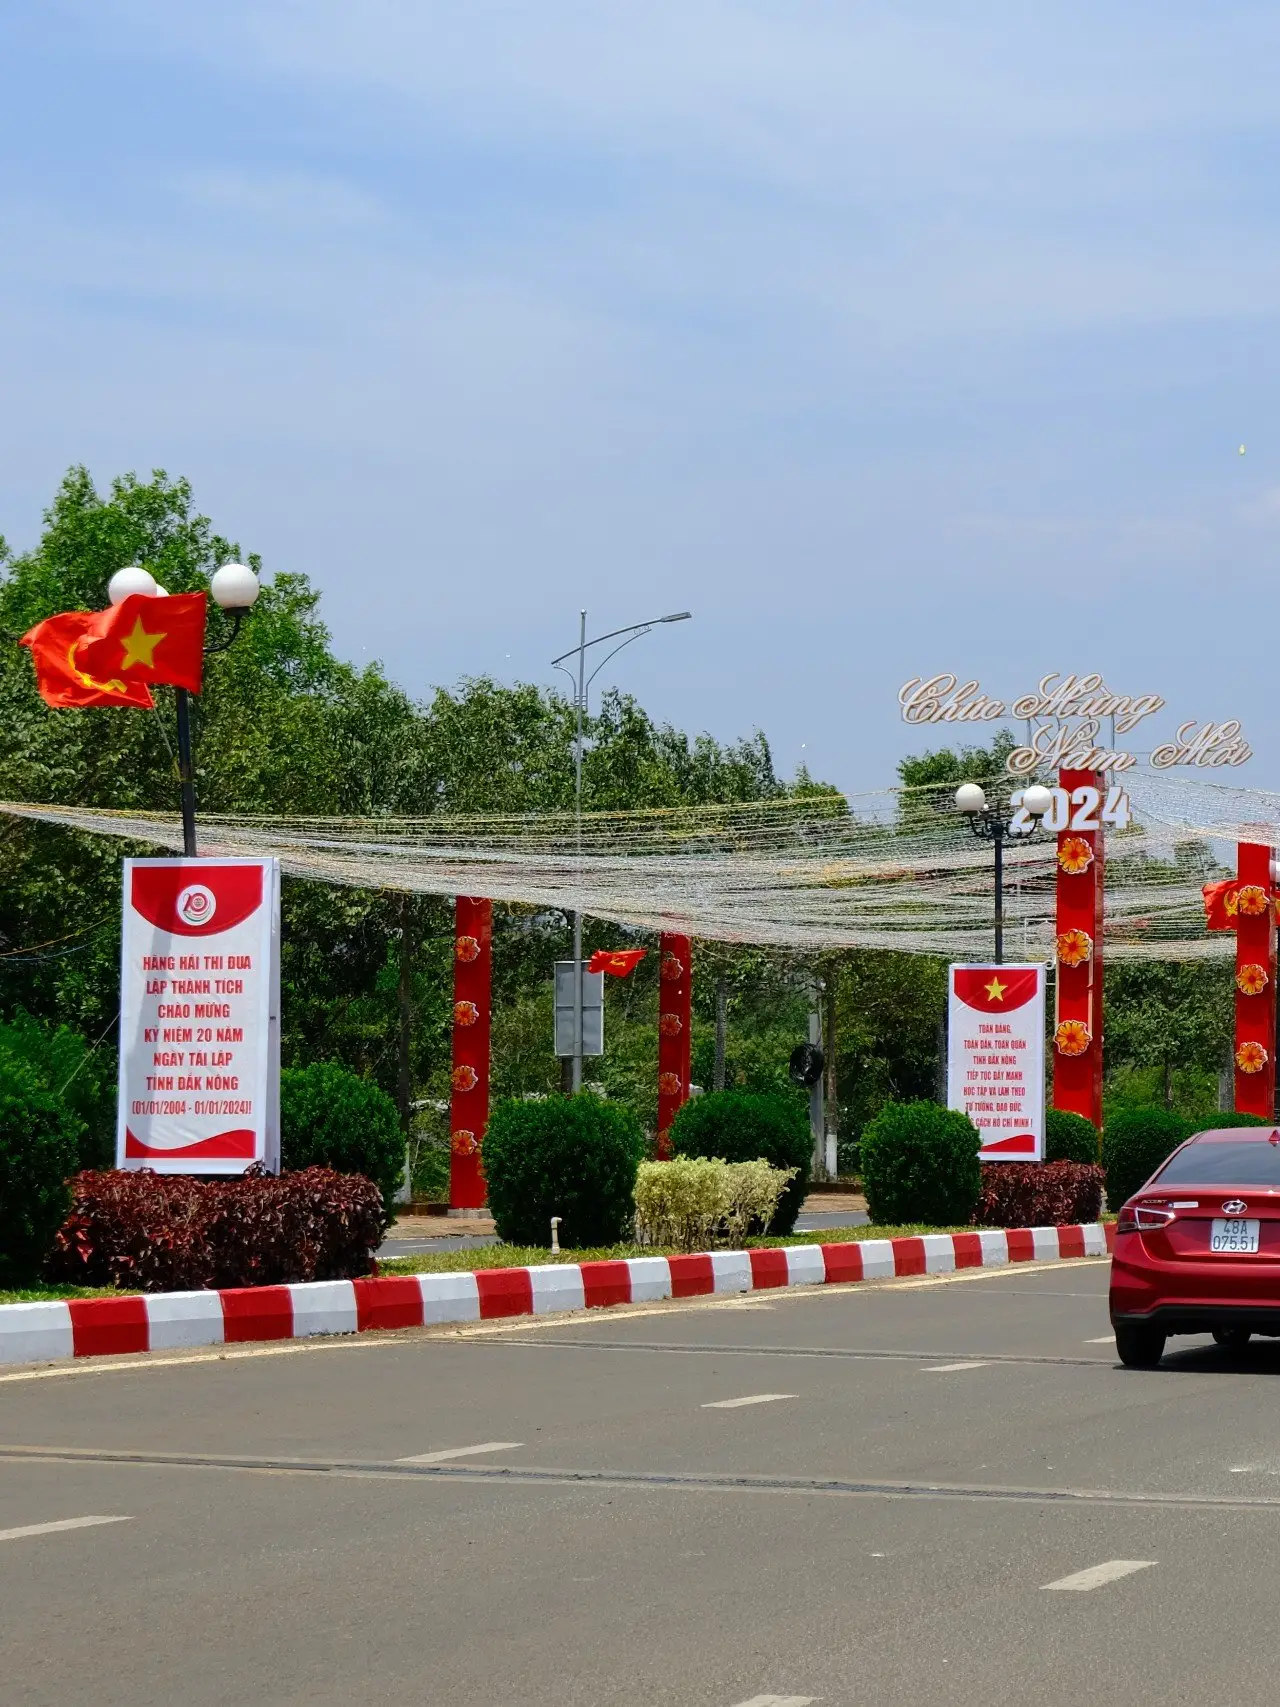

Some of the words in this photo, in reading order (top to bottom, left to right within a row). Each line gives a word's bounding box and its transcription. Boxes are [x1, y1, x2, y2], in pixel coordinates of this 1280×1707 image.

[897, 672, 1006, 725] Chúc
[1011, 672, 1166, 735] Mừng
[1006, 718, 1137, 775] Năm
[1149, 719, 1254, 770] Mới
[1008, 785, 1133, 834] 2024
[203, 955, 223, 970] THI
[227, 955, 252, 970] ĐUA
[146, 978, 168, 997] LẬP
[171, 977, 211, 994] THÀNH
[214, 977, 243, 994] TÍCH
[157, 1002, 190, 1018] CHÀO
[194, 1001, 231, 1018] MỪNG
[163, 1026, 193, 1045] NIỆM
[196, 1028, 213, 1042] 20
[153, 1050, 184, 1066] NGÀY
[188, 1050, 208, 1066] TÁI
[205, 1074, 239, 1090] NÔNG
[1011, 1086, 1026, 1096] THEO
[1223, 1220, 1248, 1234] 48A
[1213, 1235, 1255, 1251] 075.51
